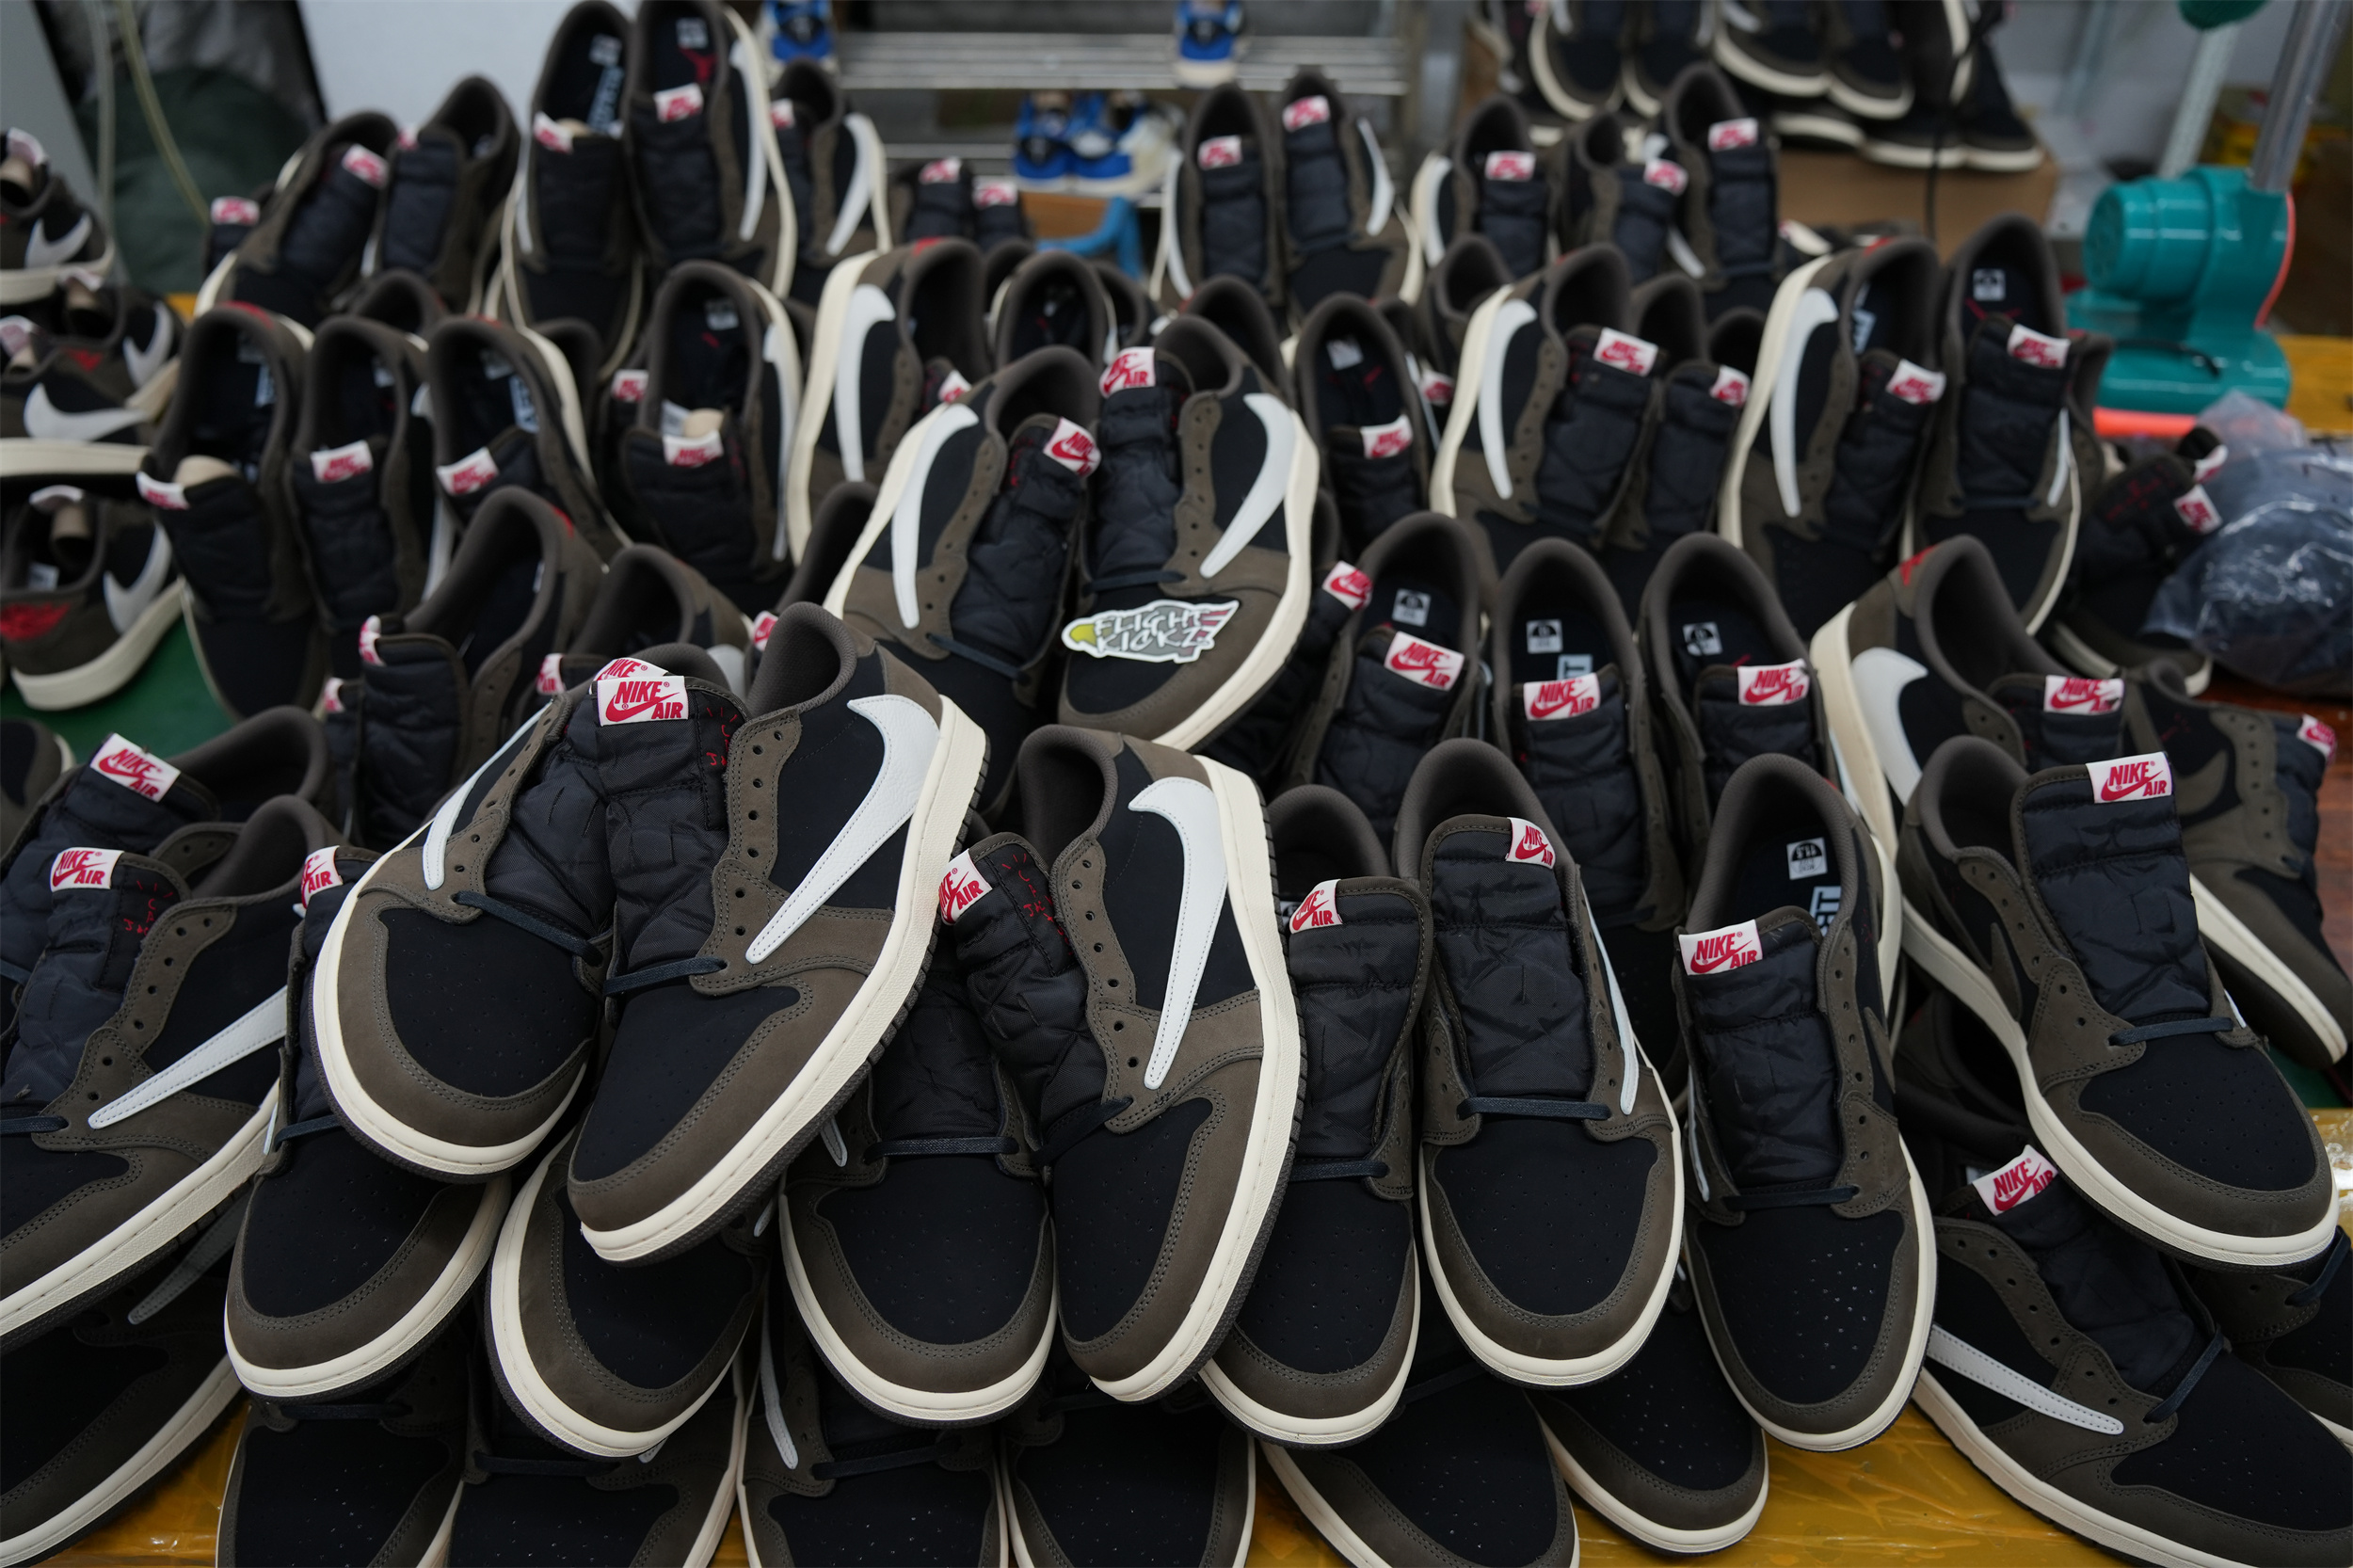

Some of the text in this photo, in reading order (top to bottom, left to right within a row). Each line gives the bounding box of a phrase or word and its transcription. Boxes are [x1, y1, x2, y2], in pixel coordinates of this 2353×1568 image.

[1123, 370, 1148, 387] AIR
[1095, 609, 1210, 636] FLIGHT
[1402, 642, 1444, 665] NIKE
[603, 658, 642, 678] NIKE
[1422, 669, 1451, 688] AIR
[1753, 667, 1792, 689] NIKE
[615, 680, 663, 704] NIKE
[1537, 680, 1577, 704] NIKE
[1784, 683, 1805, 704] AIR
[2060, 678, 2104, 697] NIKE
[650, 701, 684, 720] AIR
[1568, 696, 1595, 717] AIR
[111, 748, 157, 776] NIKE
[2107, 760, 2150, 787] NIKE
[128, 777, 160, 797] AIR
[2141, 779, 2168, 797] AIR
[1524, 824, 1544, 846] NIKE
[56, 850, 95, 871] NIKE
[1541, 848, 1554, 866] AIR
[73, 870, 106, 885] AIR
[308, 871, 333, 893] AIR
[955, 879, 984, 911] AIR
[1311, 909, 1335, 927] AIR
[1695, 933, 1737, 961] NIKE
[1729, 949, 1758, 969] AIR
[1993, 1160, 2030, 1199] NIKE
[2033, 1169, 2055, 1196] AIR
